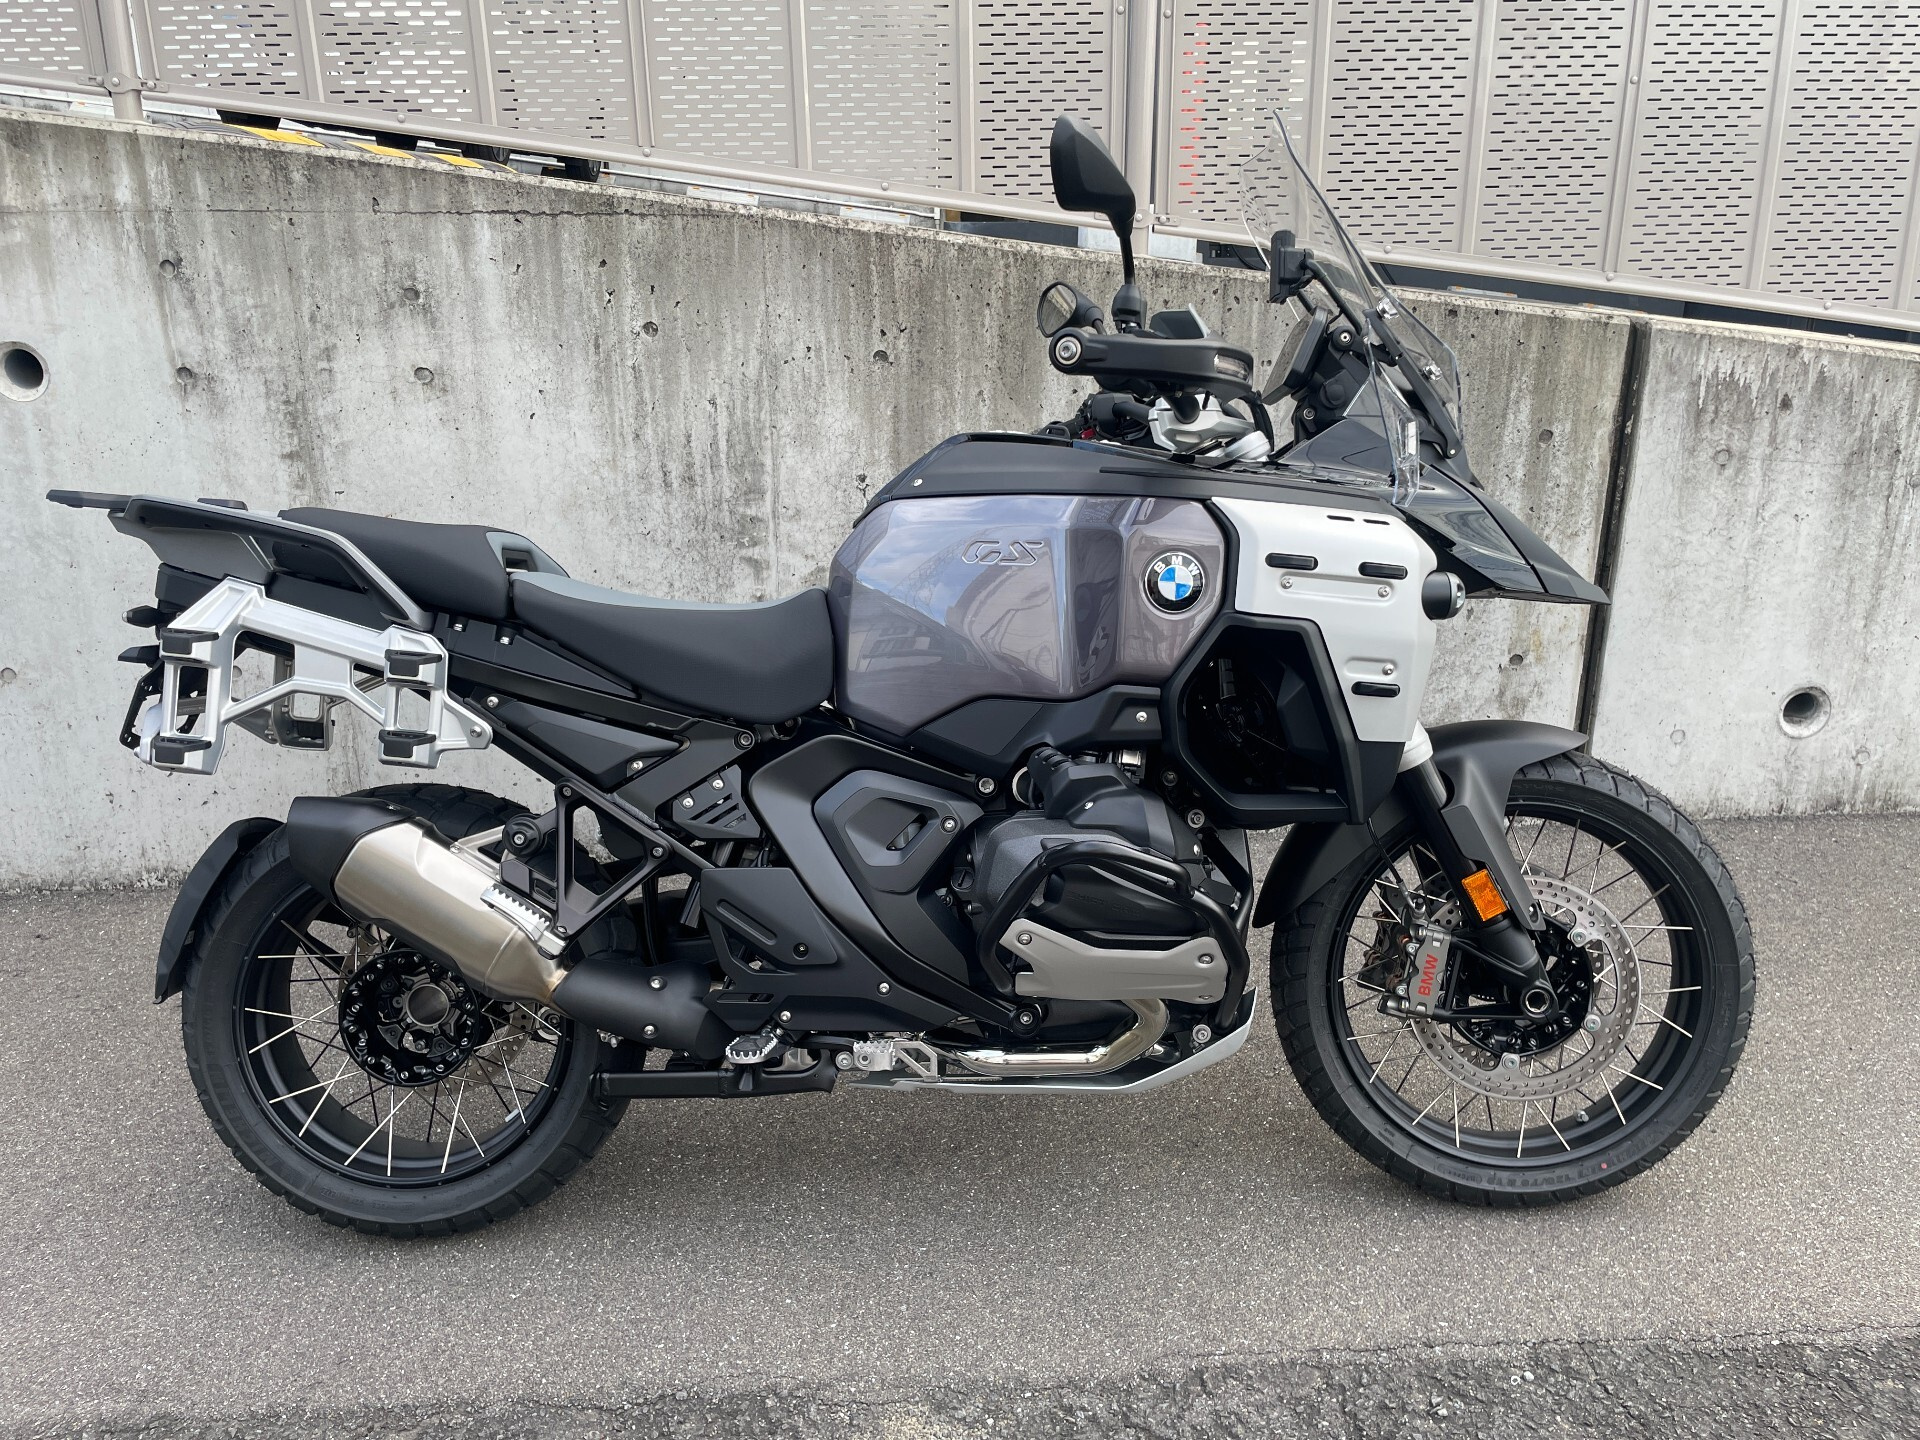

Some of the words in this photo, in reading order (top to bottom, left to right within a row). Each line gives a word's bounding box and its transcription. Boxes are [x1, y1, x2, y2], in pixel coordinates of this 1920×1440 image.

[961, 539, 1045, 566] GS
[1153, 555, 1200, 576] BMW
[1417, 953, 1439, 997] BMW
